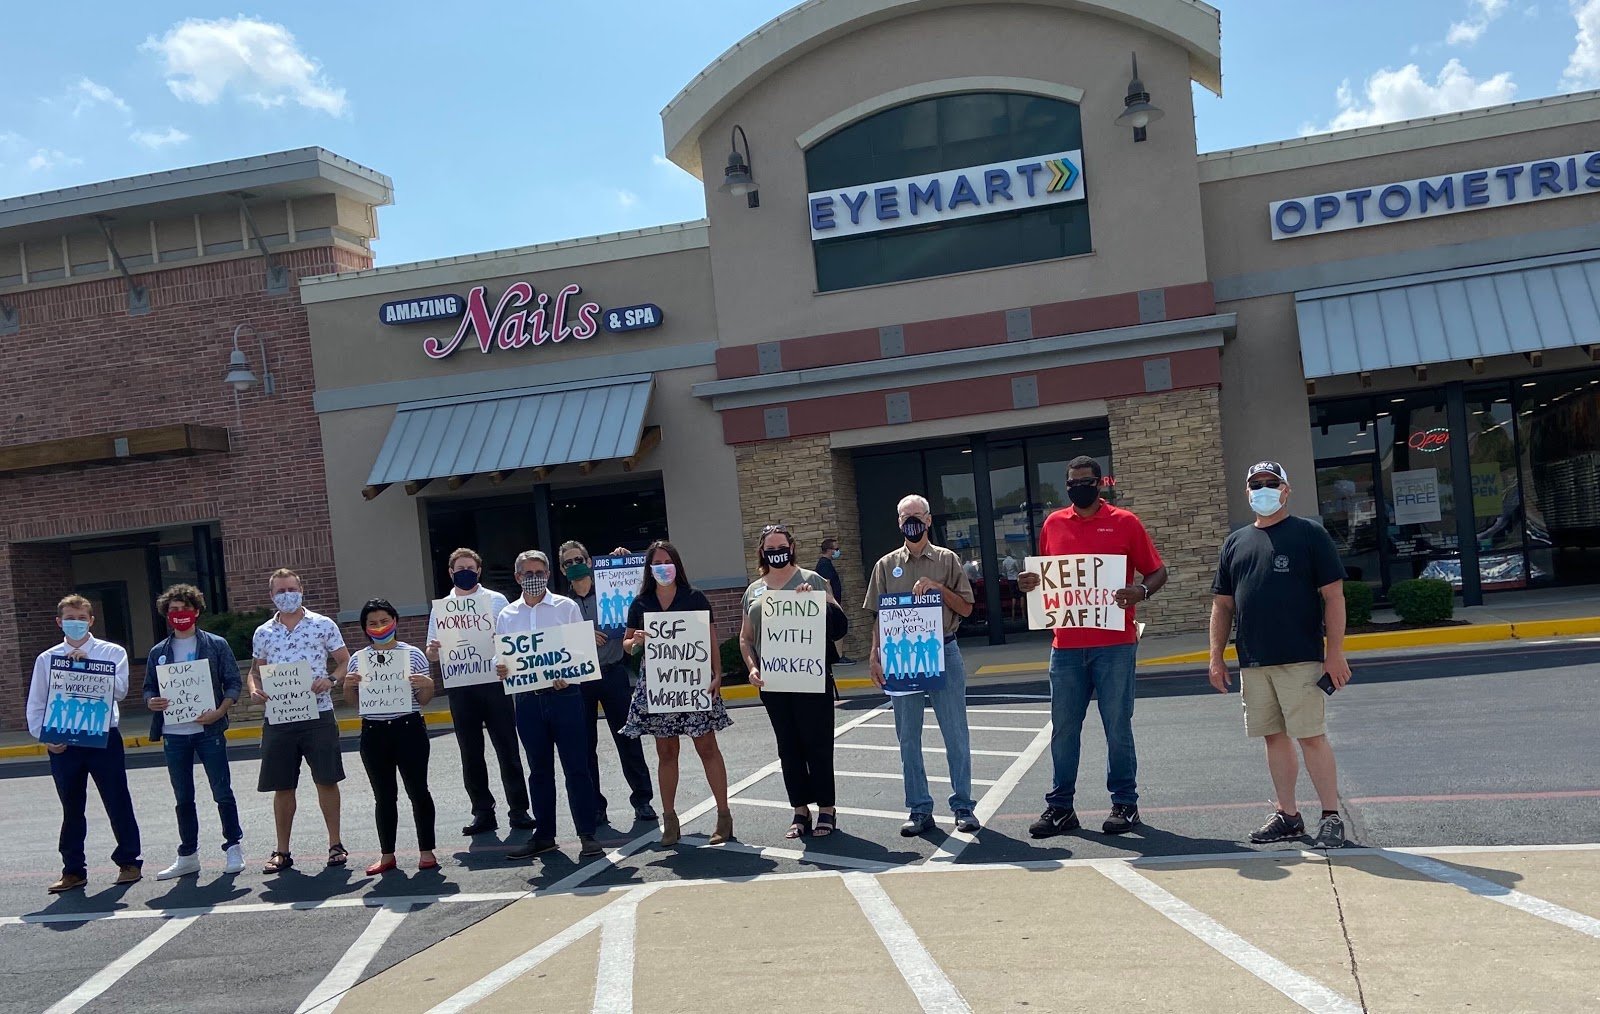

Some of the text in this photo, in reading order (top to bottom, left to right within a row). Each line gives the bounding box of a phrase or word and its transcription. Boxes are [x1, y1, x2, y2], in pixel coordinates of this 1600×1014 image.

[811, 162, 1042, 230] EYEMART
[386, 281, 655, 359] AMAZING Nails & SPA
[1408, 483, 1435, 493] PAIR
[1472, 474, 1496, 486] OW
[1396, 492, 1436, 506] FREE
[1472, 486, 1498, 497] PEN
[594, 559, 610, 568] JOBS
[768, 552, 789, 564] VOTE
[1040, 556, 1104, 591] KEEP
[446, 598, 476, 614] OUR
[764, 596, 820, 618] STAND
[880, 596, 896, 606] JOBS
[914, 594, 941, 604] JUSTICE
[1043, 588, 1116, 610] WORKERS
[436, 613, 492, 631] WORKERS
[882, 608, 919, 622] STANDS
[1046, 606, 1108, 628] SAFE!
[649, 619, 686, 640] SGF
[768, 628, 812, 644] WITH
[501, 632, 544, 656] SGF
[647, 640, 708, 662] STANDS
[448, 646, 482, 662] OUR
[516, 648, 572, 671] STANDS
[52, 658, 70, 668] JOBS
[86, 662, 114, 672] JUSTICE
[168, 664, 195, 674] OUR
[266, 668, 298, 678] Stand
[442, 658, 492, 680] COMMUNIT
[543, 660, 596, 680] WORKERS
[762, 656, 823, 676] WORKERS
[52, 671, 114, 684] We SUPPORT
[52, 681, 63, 690] the
[273, 678, 301, 688] with
[367, 684, 404, 694] with
[648, 688, 710, 710] WORKERS
